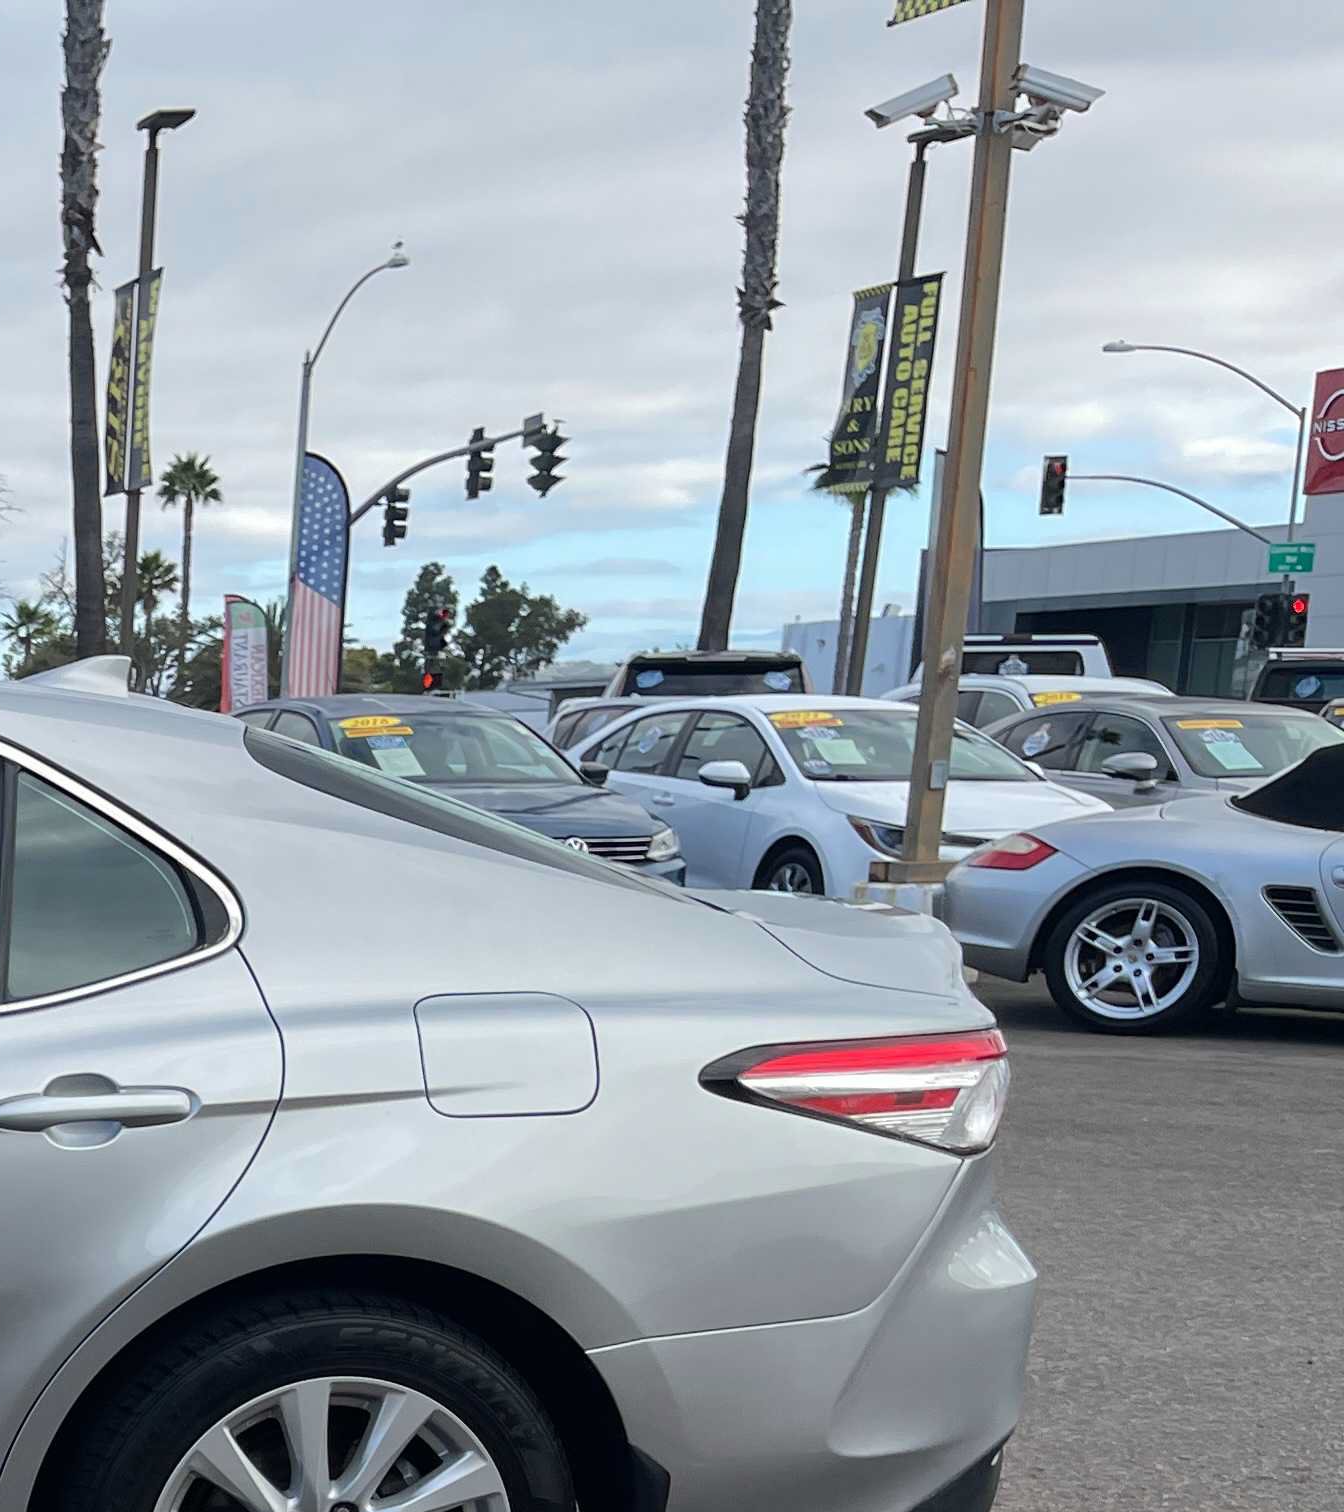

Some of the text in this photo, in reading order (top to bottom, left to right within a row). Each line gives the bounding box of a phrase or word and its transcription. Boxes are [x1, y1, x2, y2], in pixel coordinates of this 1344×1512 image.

[885, 304, 919, 464] AUTO CARE
[900, 281, 939, 480] FULL SERVICE
